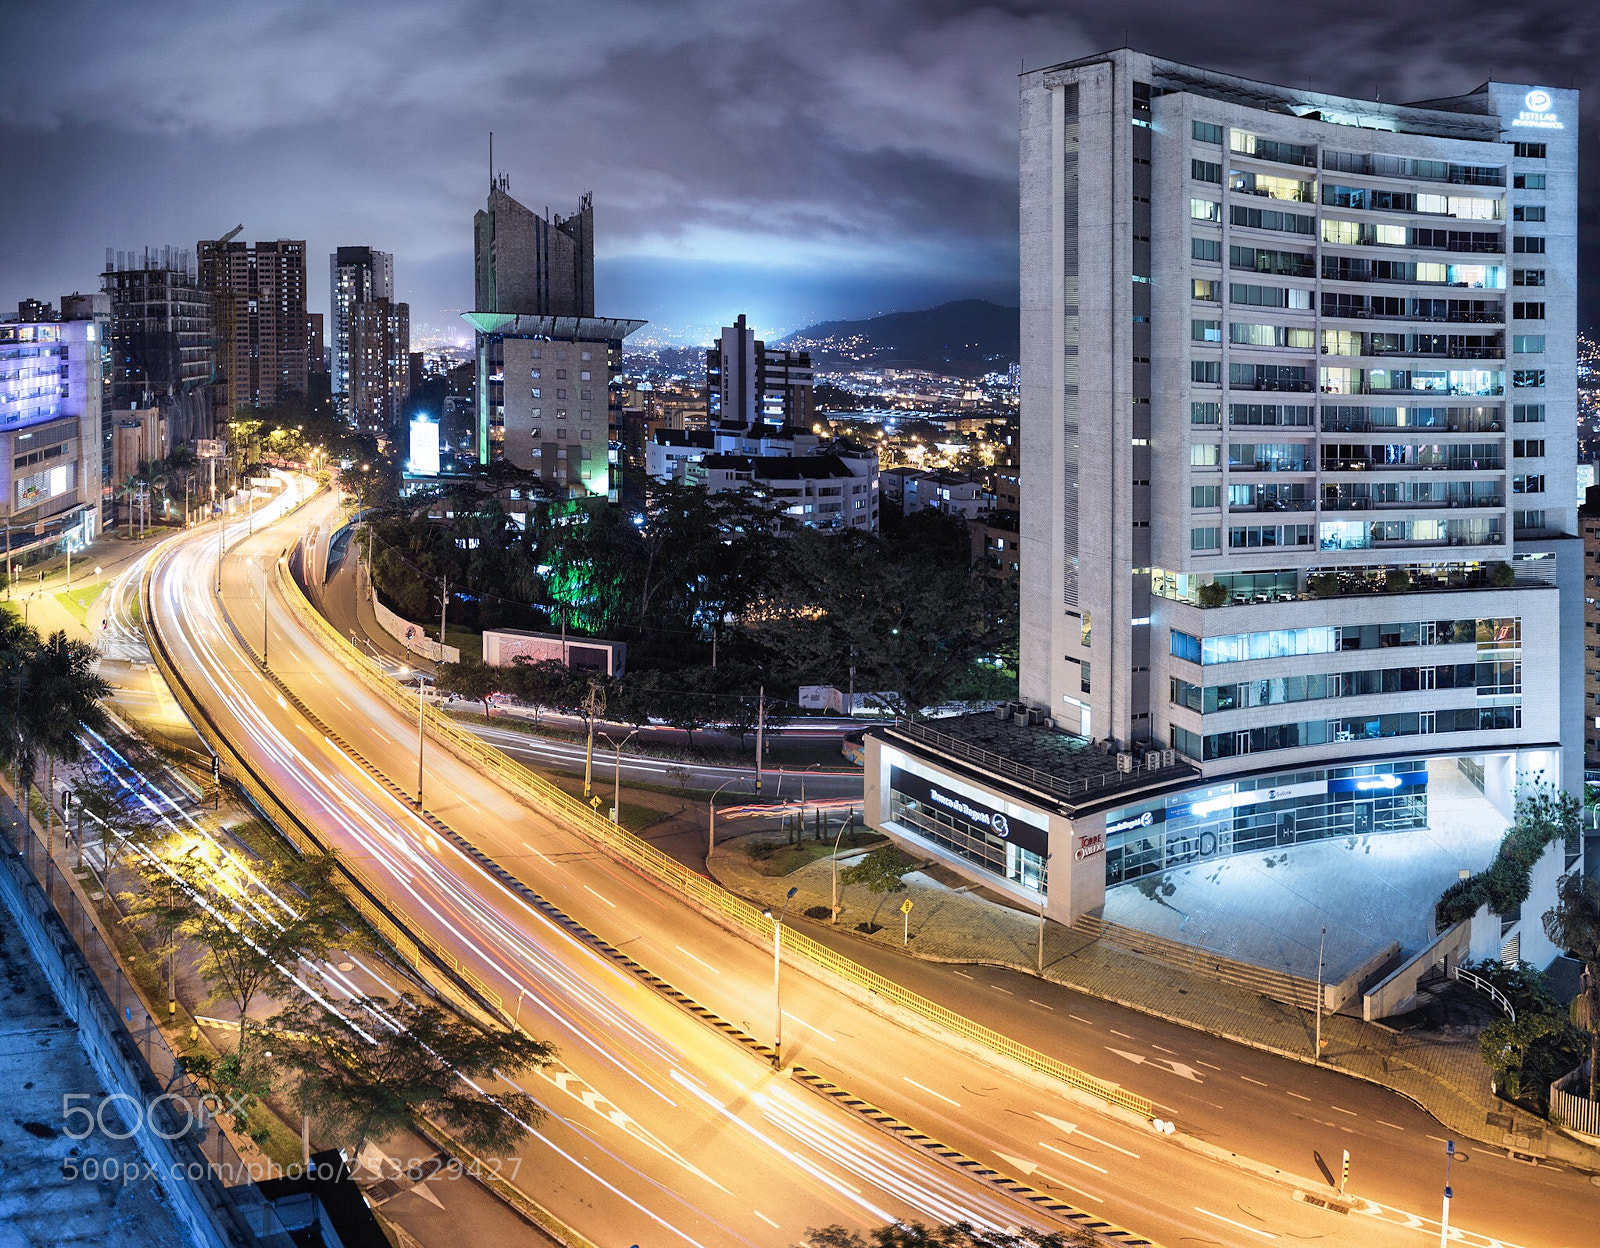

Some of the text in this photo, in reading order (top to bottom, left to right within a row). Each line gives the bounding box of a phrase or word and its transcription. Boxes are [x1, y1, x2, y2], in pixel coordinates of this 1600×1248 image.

[1519, 110, 1557, 121] ESTELAR
[930, 788, 954, 808] Banco
[953, 799, 963, 812] de
[1078, 834, 1102, 848] TORRE
